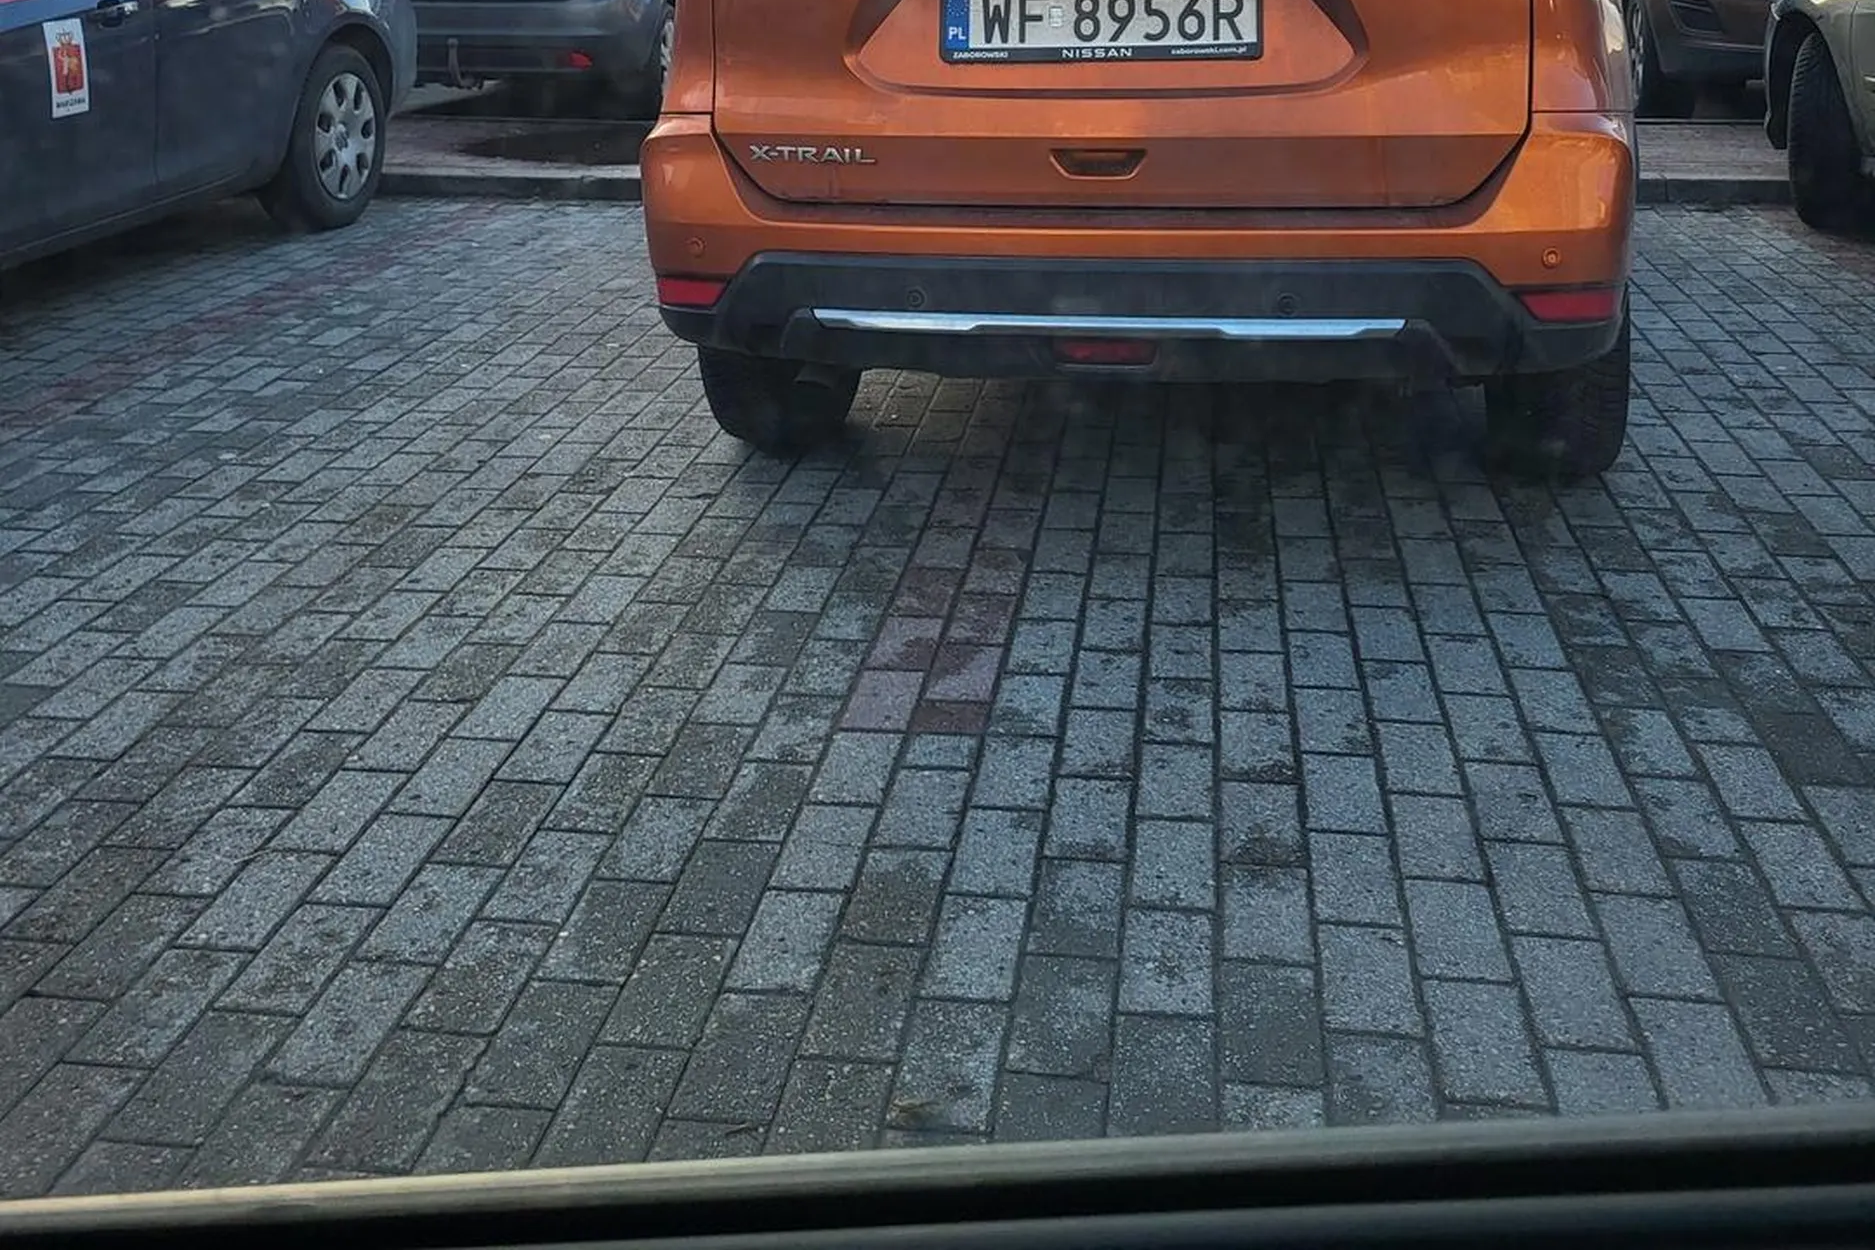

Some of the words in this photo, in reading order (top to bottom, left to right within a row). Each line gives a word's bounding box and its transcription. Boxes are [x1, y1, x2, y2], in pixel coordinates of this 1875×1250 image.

[949, 26, 967, 41] PL
[1061, 47, 1133, 59] NISSAN
[750, 145, 877, 164] X-TRAIL
